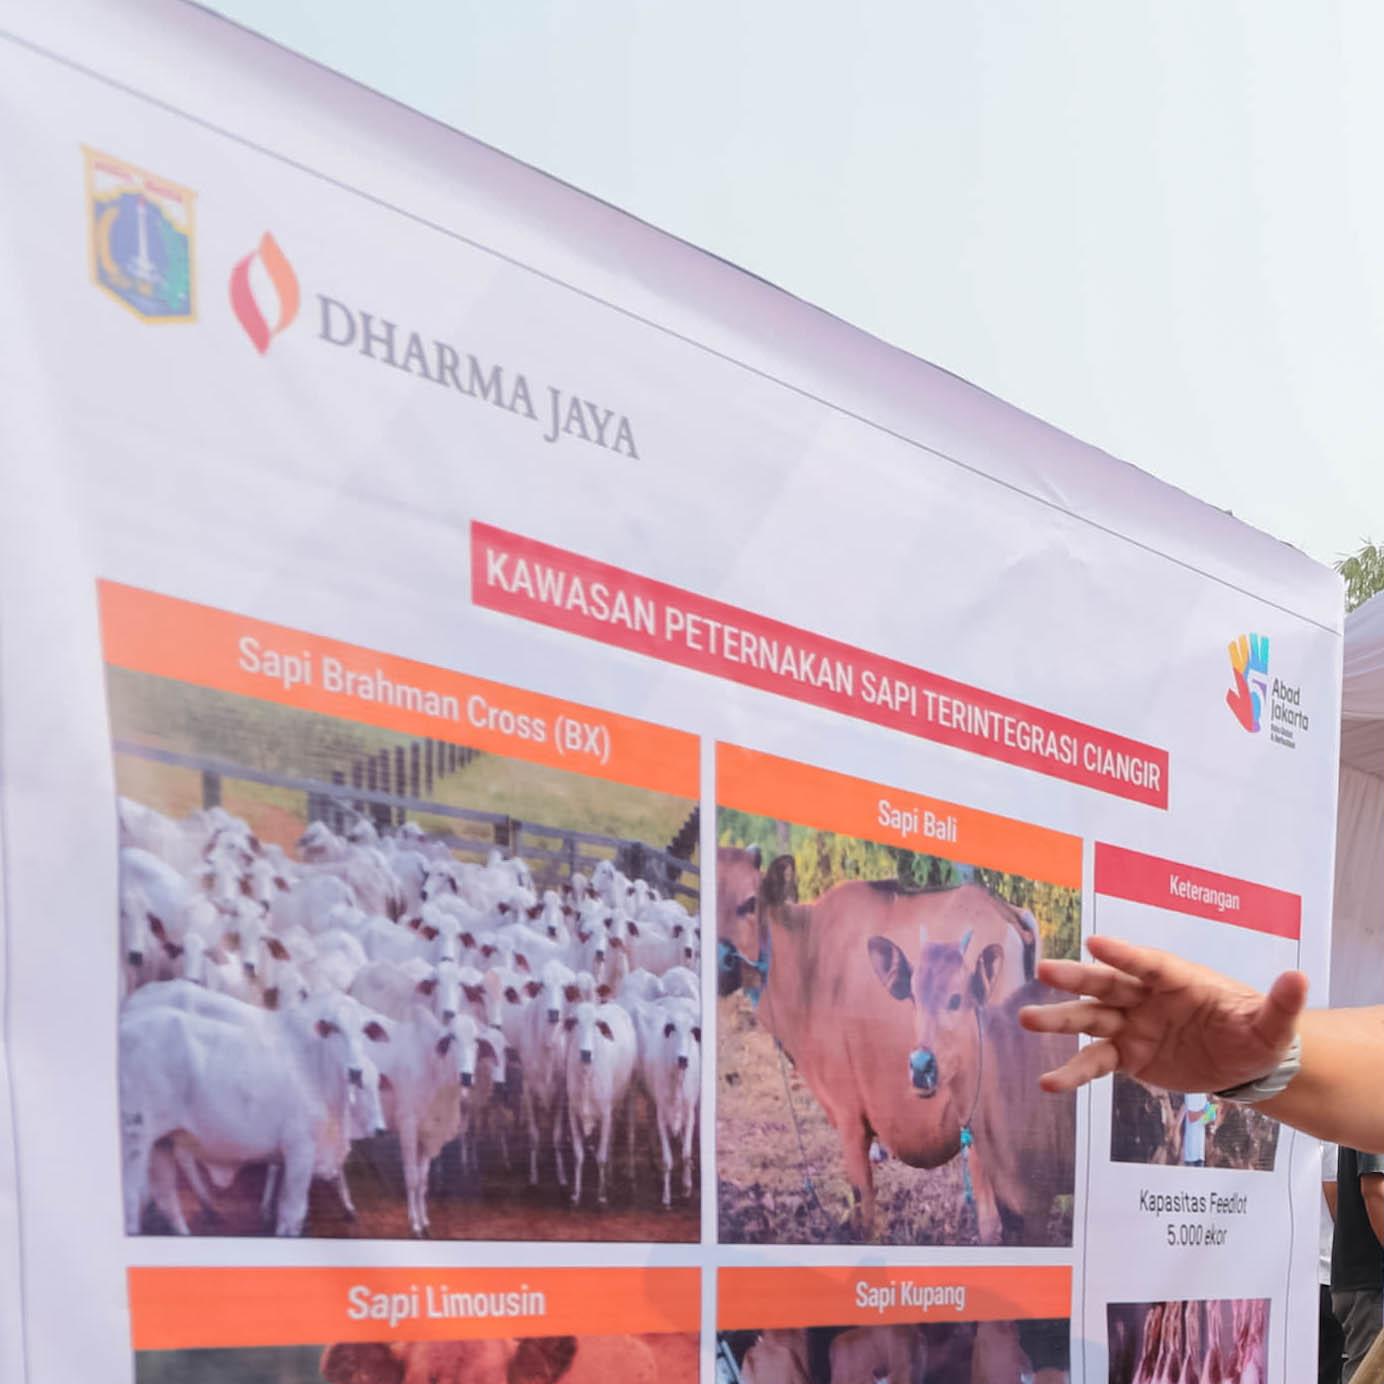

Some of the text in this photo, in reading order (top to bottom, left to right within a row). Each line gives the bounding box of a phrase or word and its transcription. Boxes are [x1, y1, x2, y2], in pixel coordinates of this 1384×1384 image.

[316, 293, 641, 460] DHARMA JAYA
[485, 548, 1162, 792] KAWASAN PETERNAKAN SAPI TERINTEGRASI CIANGIR
[238, 635, 612, 765] Sapi Brahman Cross (BX)
[1271, 677, 1301, 706] Abad
[1271, 699, 1309, 731] Jakarta
[878, 800, 957, 843] Sapi Bali
[1169, 875, 1241, 913] Keterangan
[1139, 1188, 1248, 1217] Kapasitas Feedlot
[1167, 1224, 1228, 1247] 5.000 ekor
[347, 1283, 546, 1329] Sapi Limousin
[856, 1280, 967, 1313] Sapi Kupang
